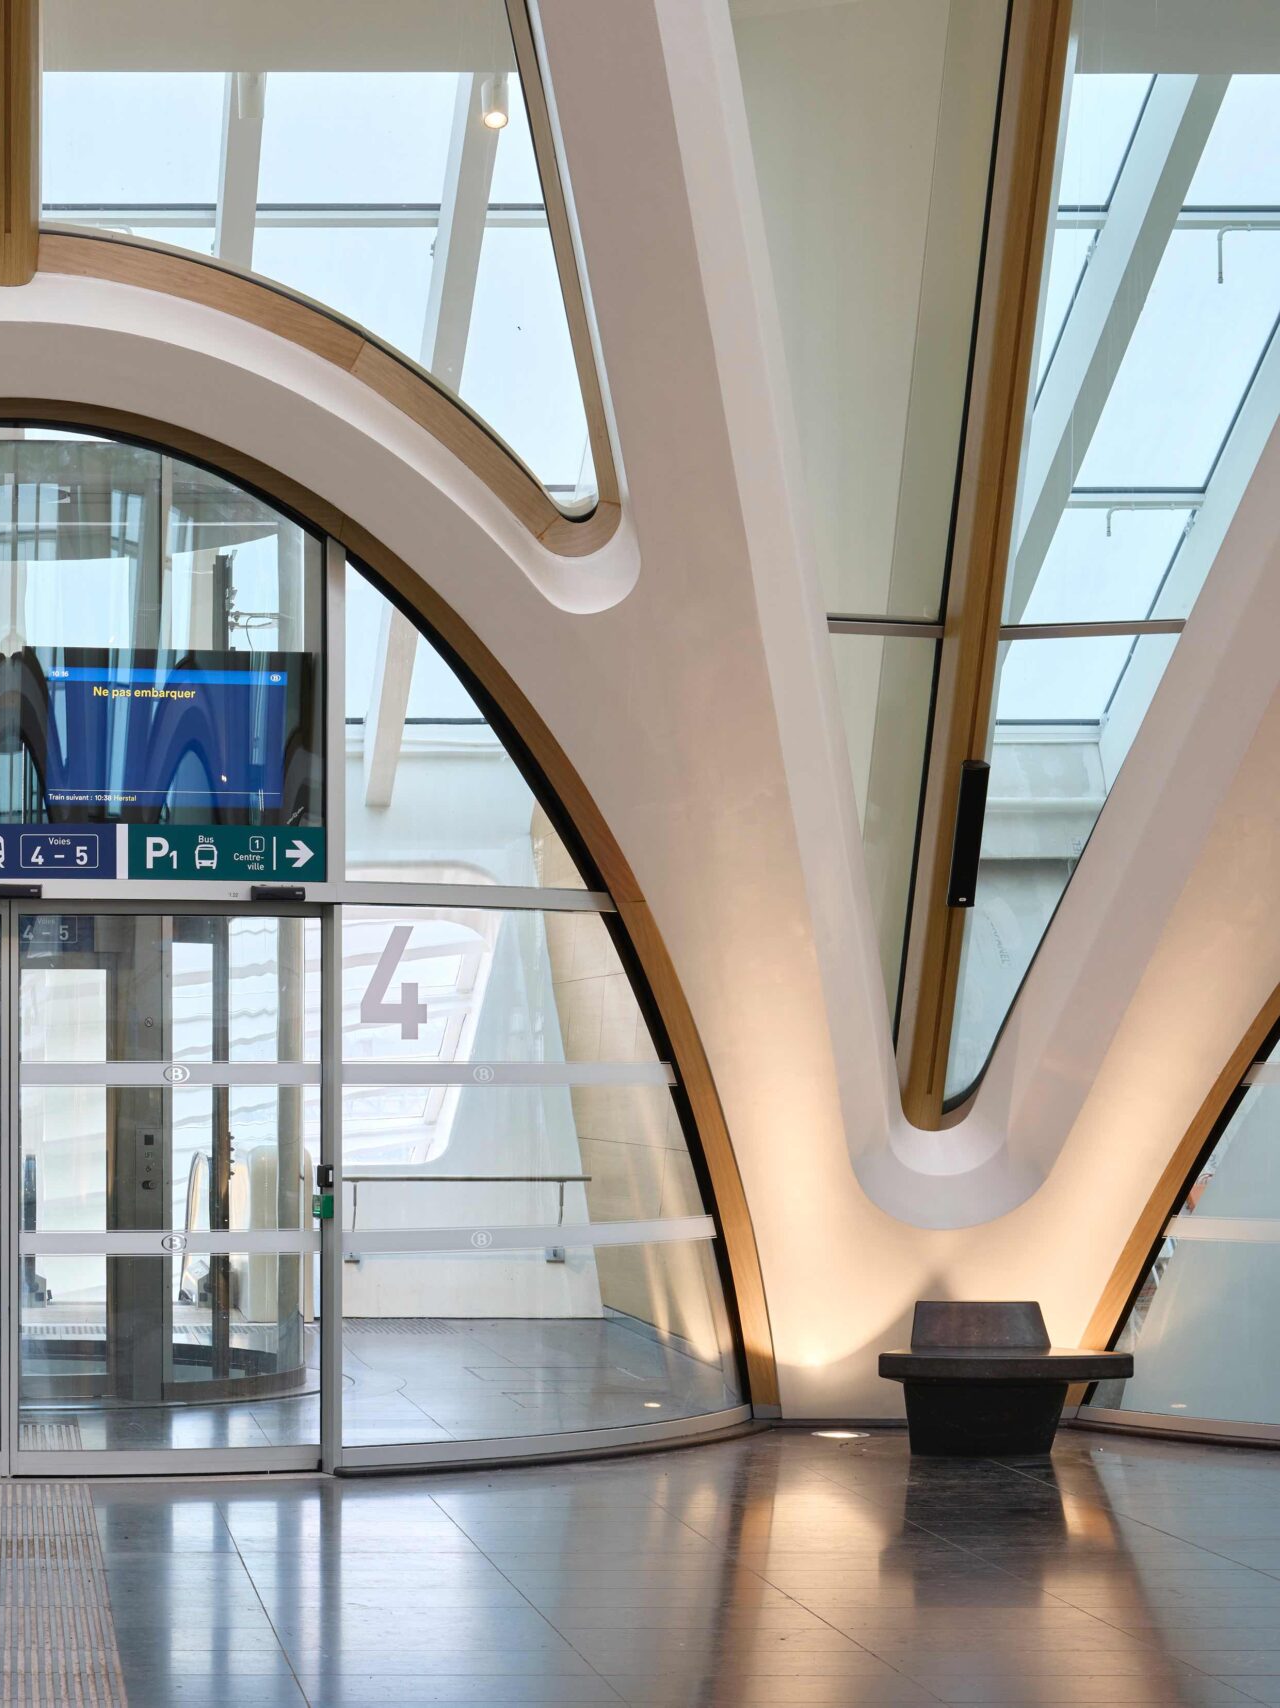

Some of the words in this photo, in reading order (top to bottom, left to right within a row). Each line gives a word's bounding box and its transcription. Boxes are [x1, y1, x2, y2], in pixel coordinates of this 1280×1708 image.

[93, 686, 109, 696] Ne
[111, 688, 131, 698] pas
[134, 687, 196, 700] embarquer
[48, 793, 65, 801] Train
[113, 794, 137, 802] Herstal
[48, 837, 71, 846] Voies
[198, 835, 215, 844] Bus
[30, 846, 44, 865] 4
[76, 846, 88, 865] 5
[233, 852, 265, 861] Centre-
[247, 862, 265, 871] ville
[23, 925, 34, 940] 4
[59, 925, 69, 940] 5
[360, 926, 428, 1041] 4
